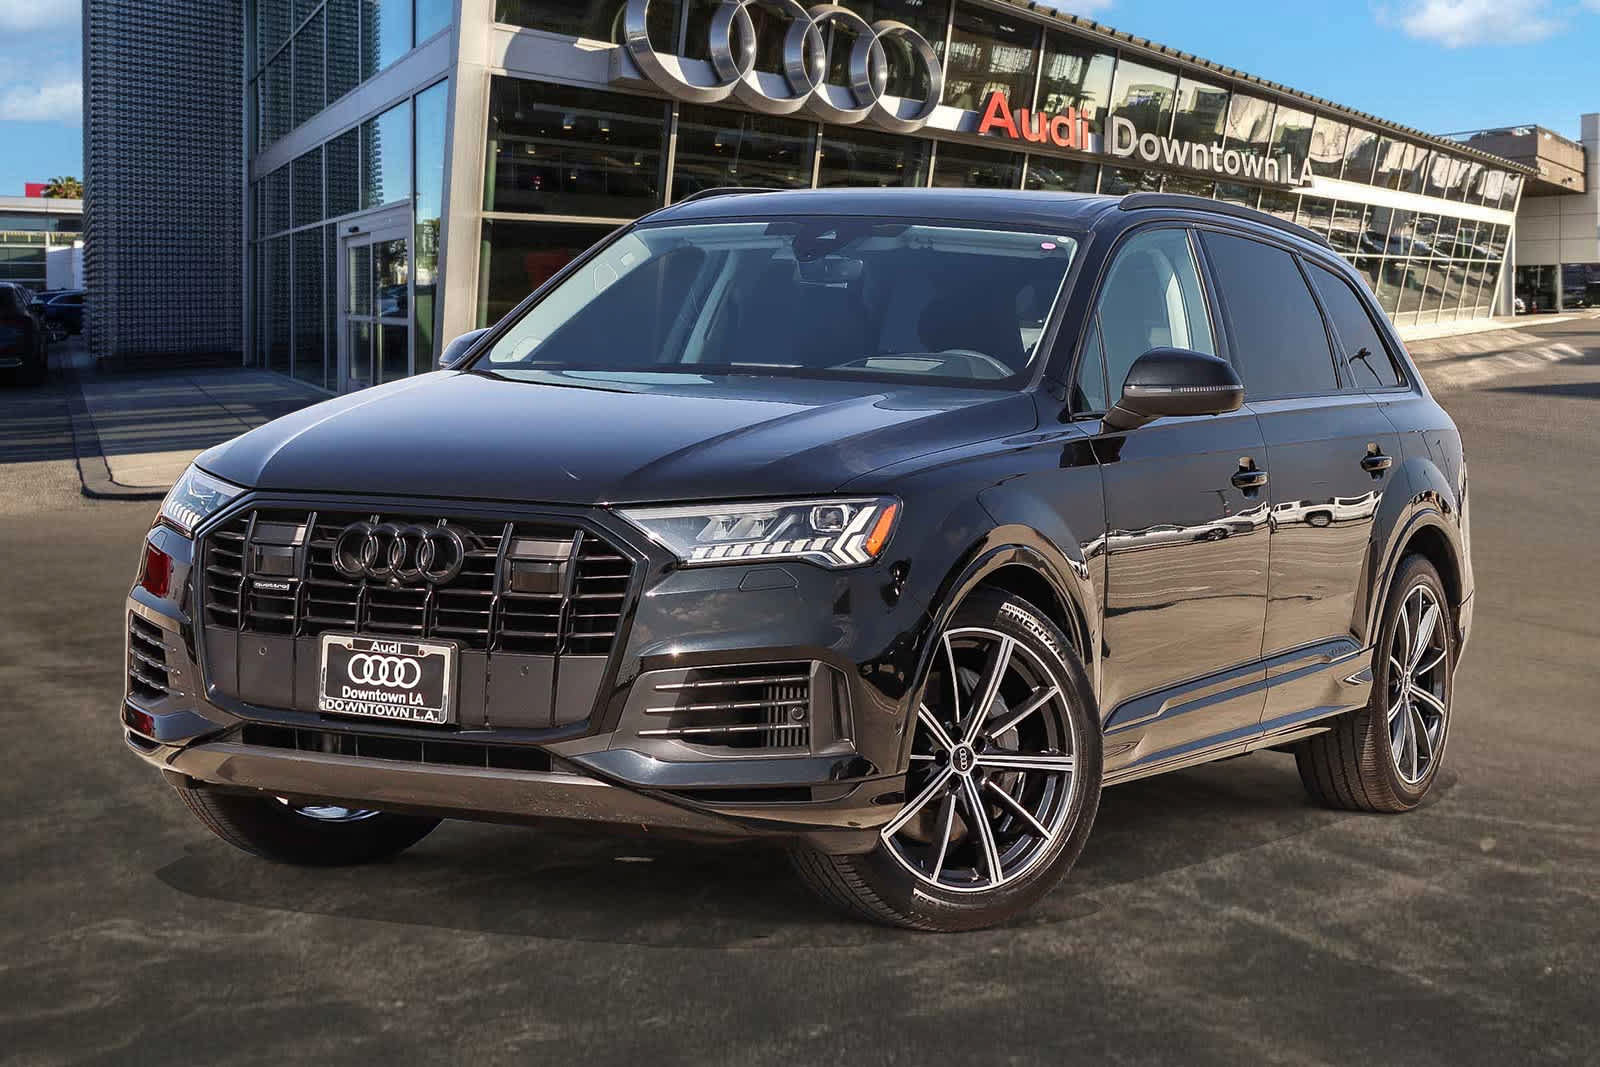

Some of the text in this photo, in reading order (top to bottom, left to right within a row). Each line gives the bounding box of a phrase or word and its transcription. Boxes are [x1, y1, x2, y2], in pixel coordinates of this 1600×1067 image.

[978, 91, 1312, 187] Audi Downtown LA
[370, 641, 401, 654] Audi
[342, 685, 424, 706] Downtown LA
[325, 699, 438, 721] DOWNTOWN L.A.
